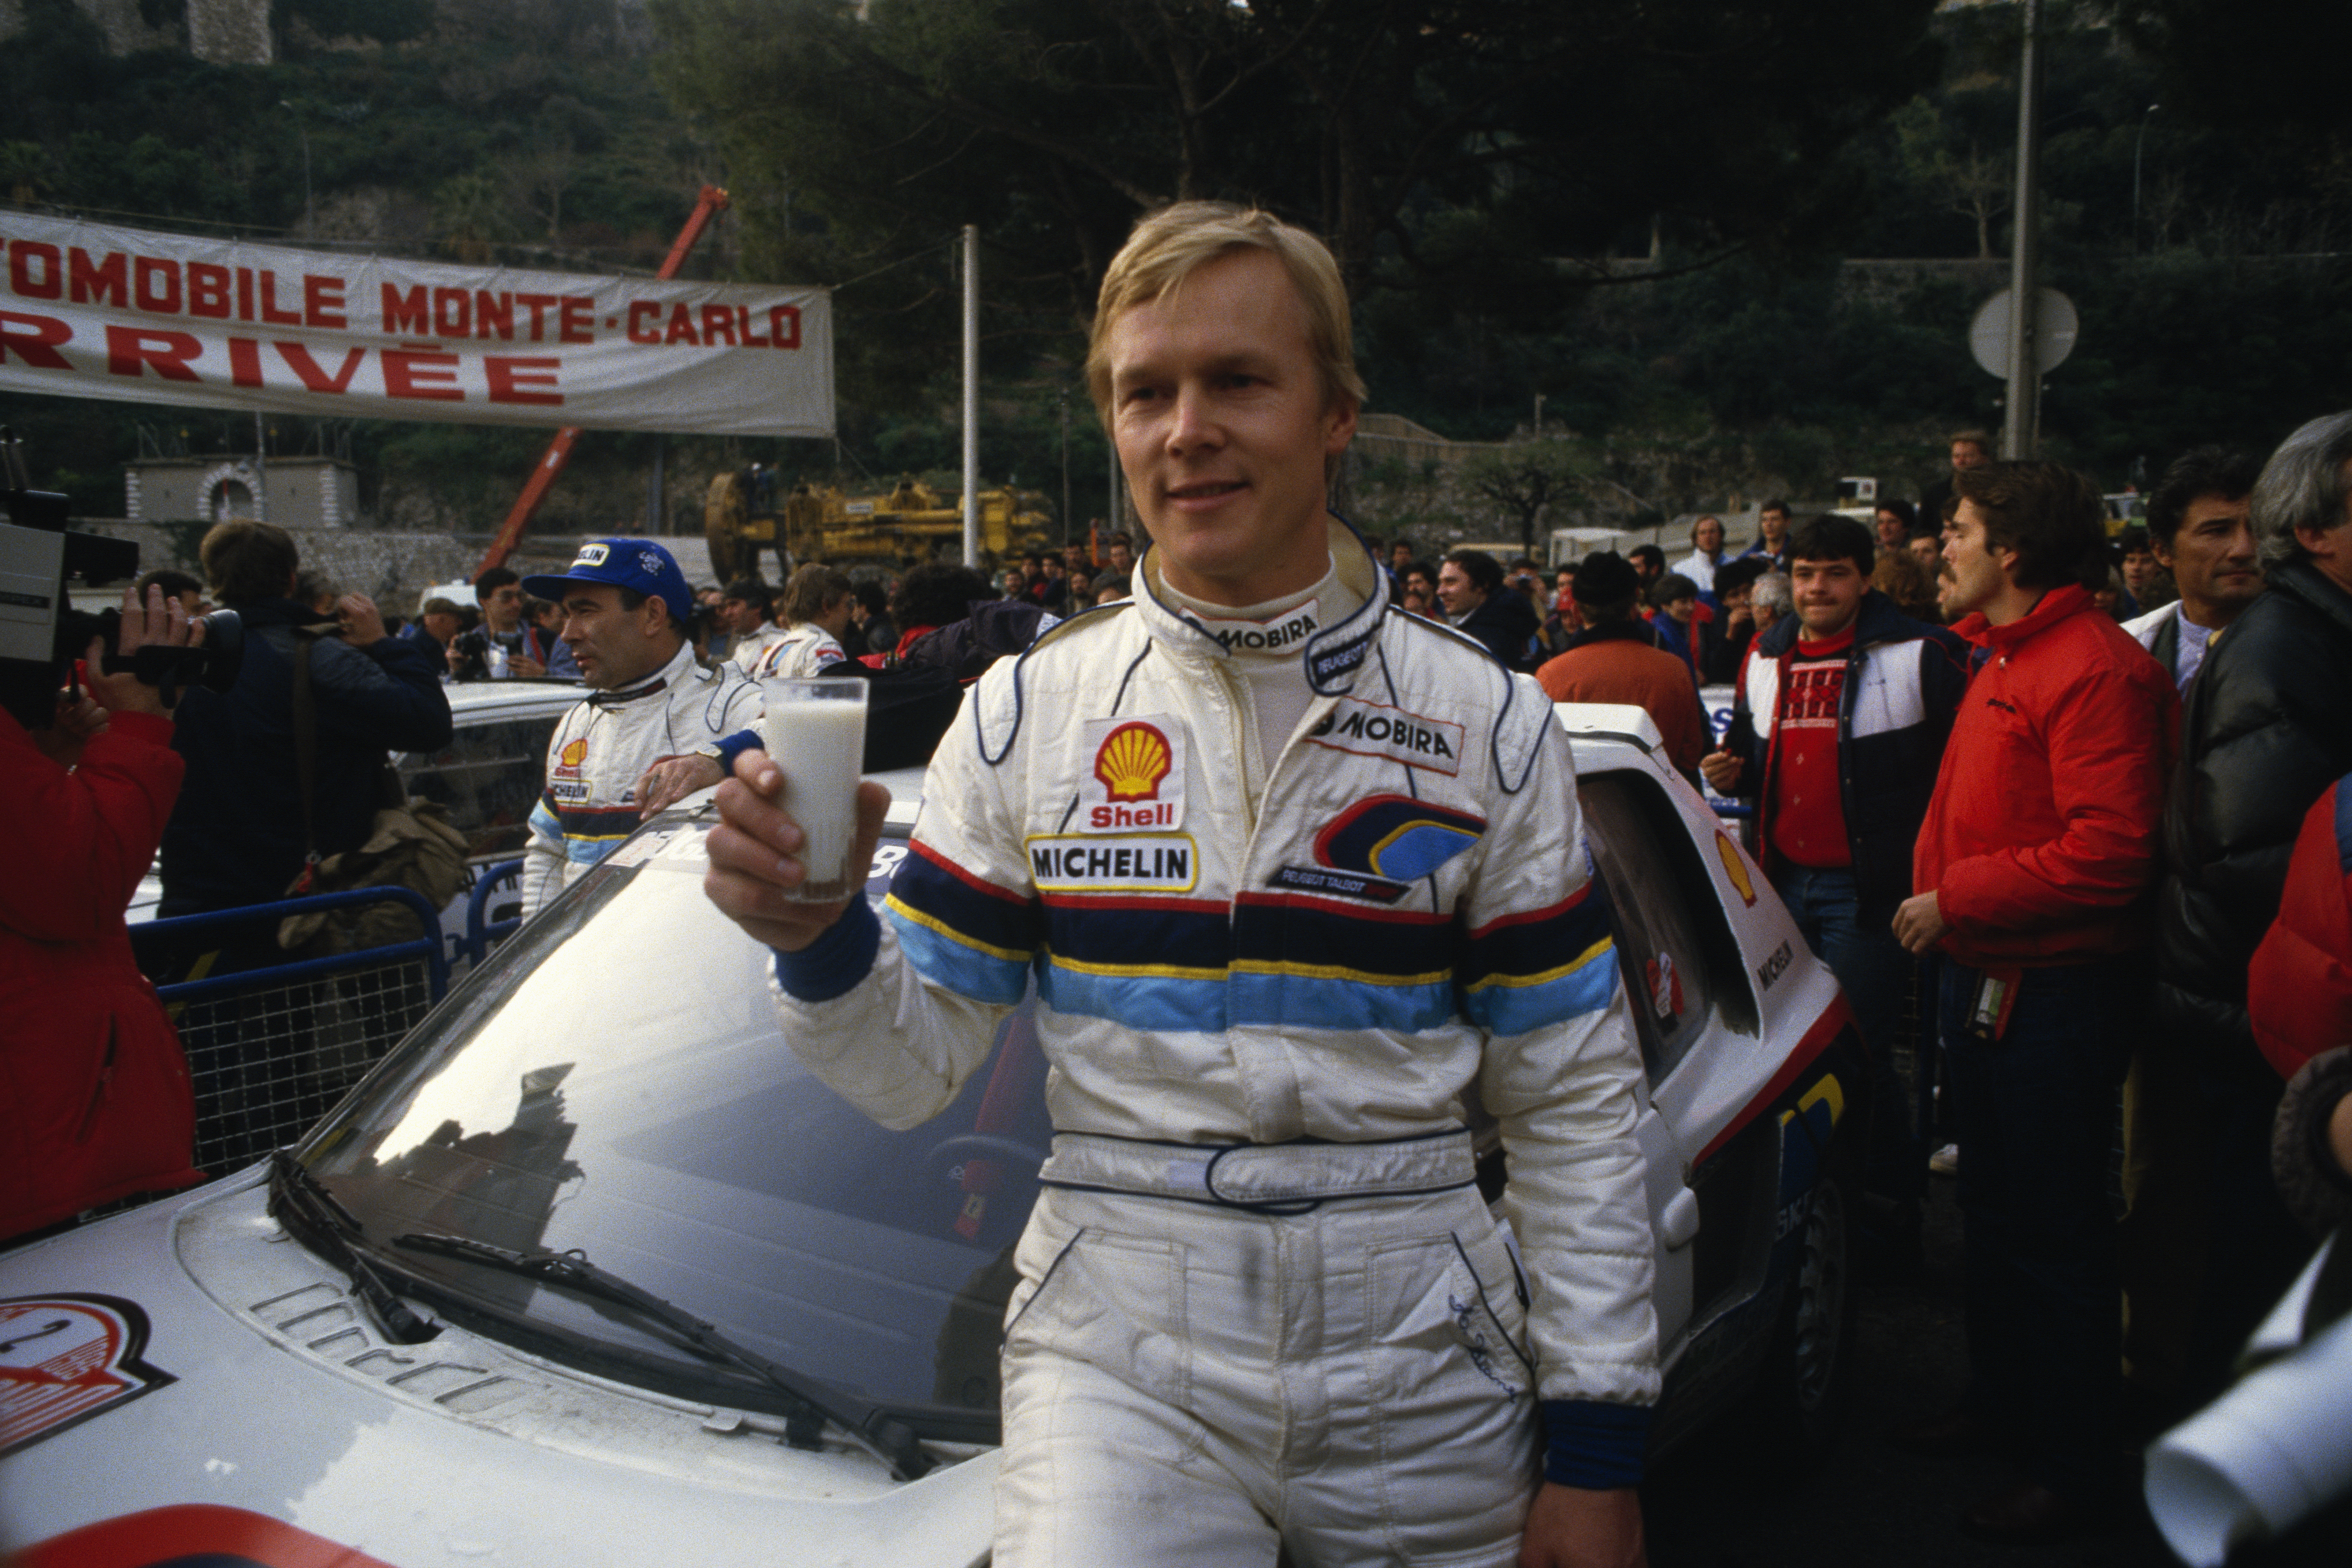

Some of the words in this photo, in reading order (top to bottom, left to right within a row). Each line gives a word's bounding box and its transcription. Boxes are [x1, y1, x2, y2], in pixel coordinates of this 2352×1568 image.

[0, 238, 347, 329] OMOBILE
[1216, 614, 1317, 648] MOBIRA
[1339, 711, 1455, 759] MOBIRA
[1090, 803, 1173, 828] Shell
[1032, 848, 1187, 879] MICHELIN
[1326, 876, 1367, 893] TALBOT
